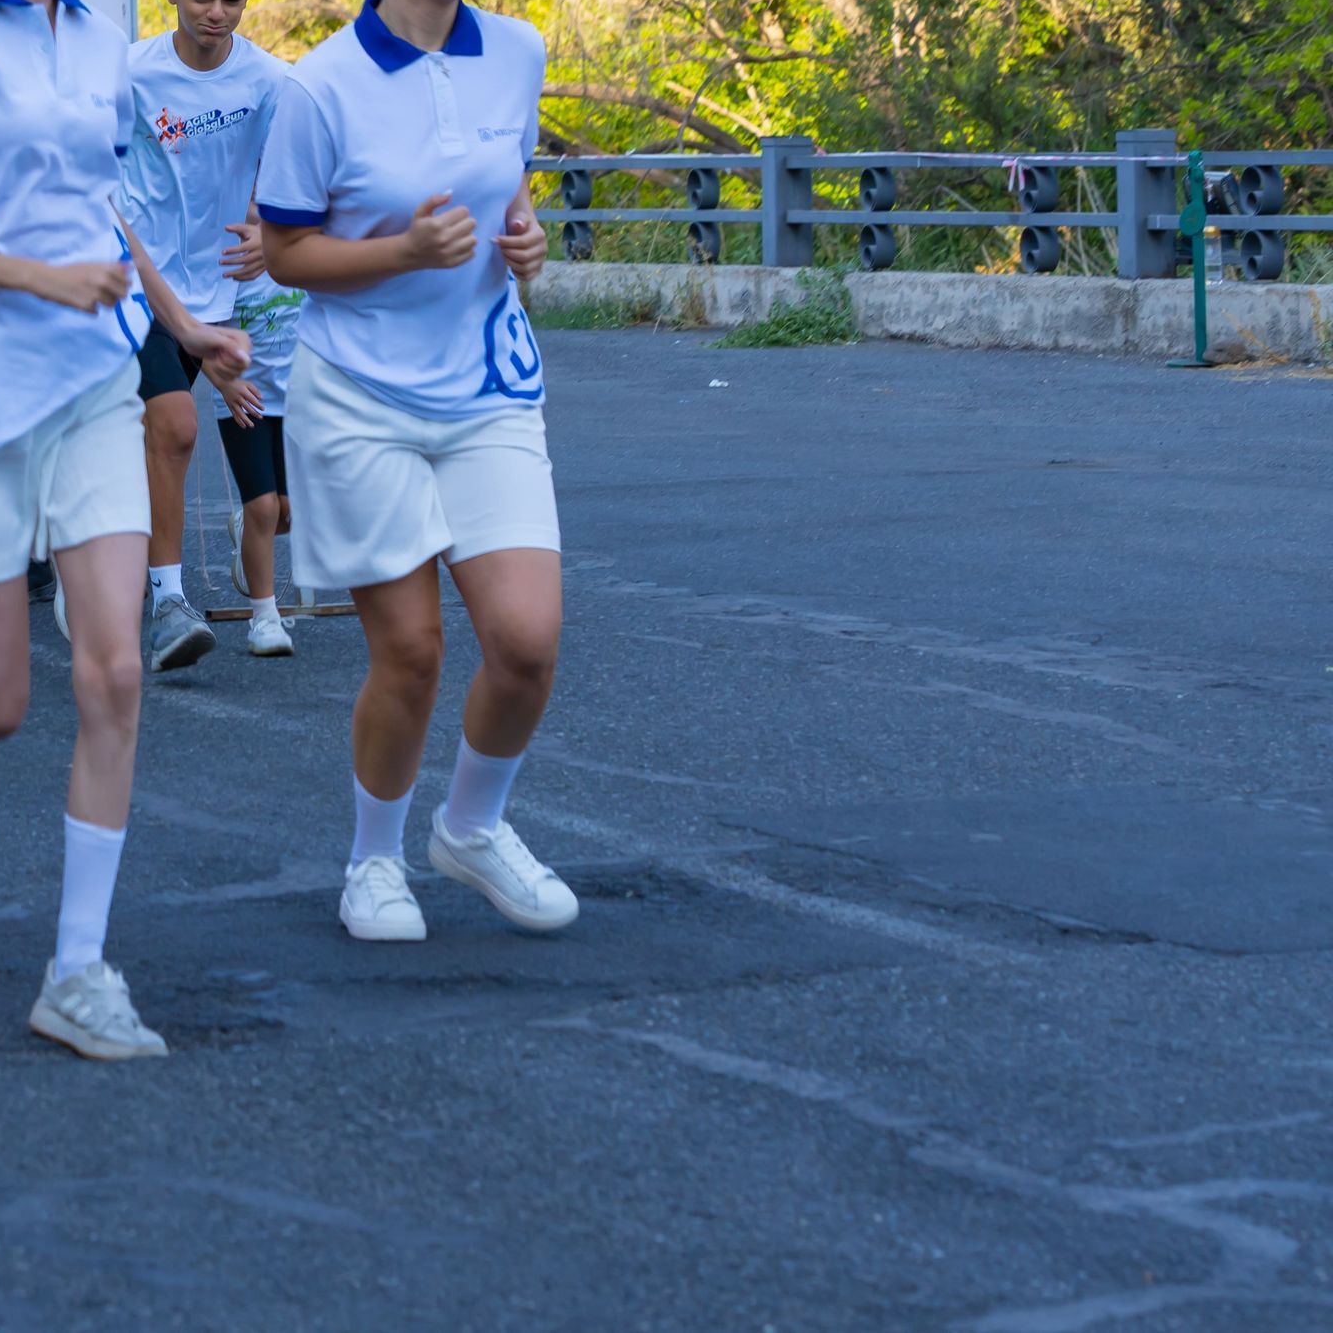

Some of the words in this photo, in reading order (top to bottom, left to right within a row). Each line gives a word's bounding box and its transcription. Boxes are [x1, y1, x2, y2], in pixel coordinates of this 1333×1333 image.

[186, 110, 216, 130] AGBU
[187, 117, 222, 138] Global
[223, 110, 244, 125] Run
